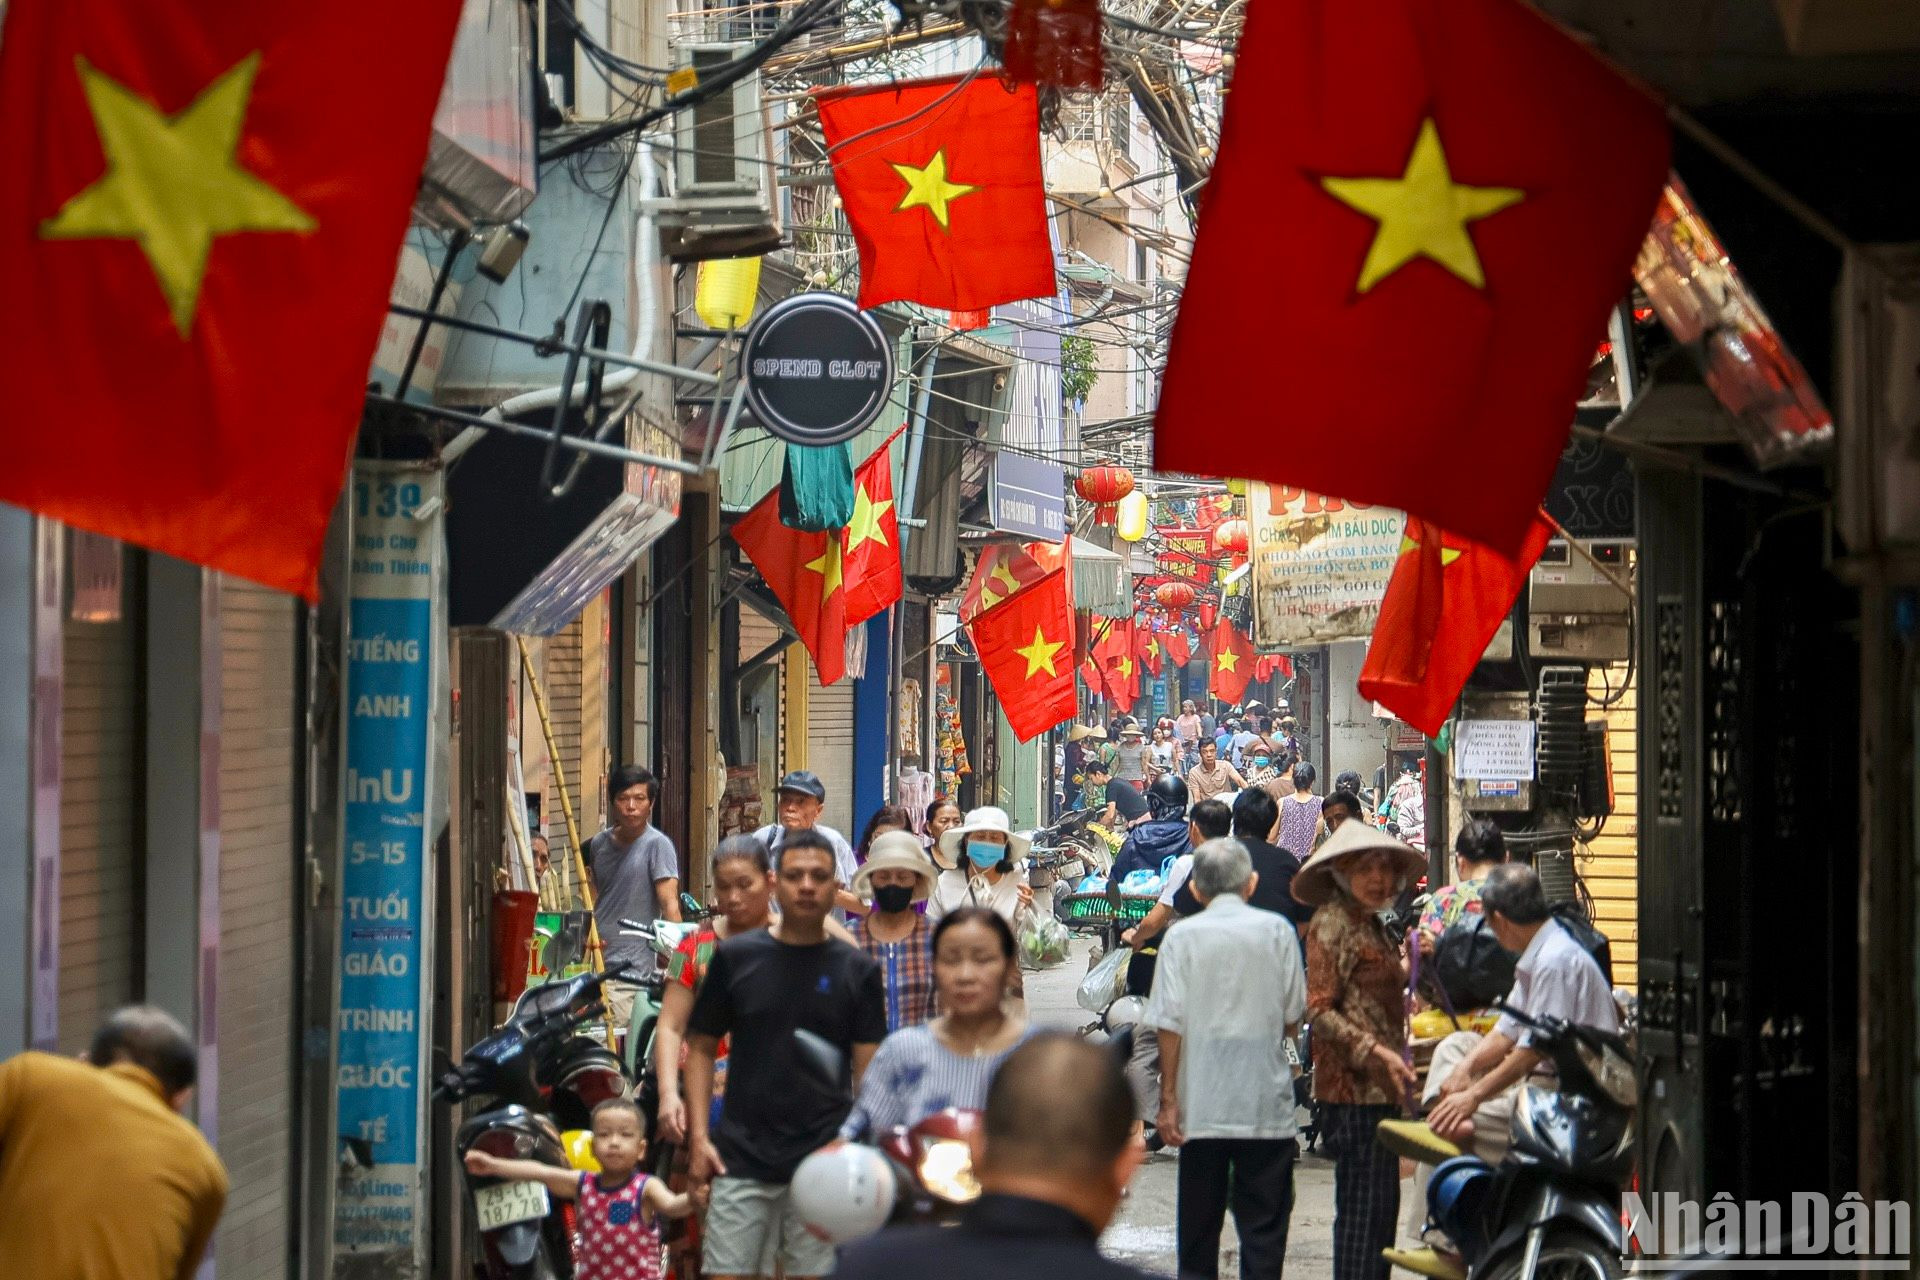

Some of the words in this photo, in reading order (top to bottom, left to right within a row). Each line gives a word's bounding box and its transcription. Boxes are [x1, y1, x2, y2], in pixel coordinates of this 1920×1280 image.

[752, 358, 822, 377] SPEND
[828, 360, 881, 378] CLOT
[1371, 517, 1397, 539] DỤC
[348, 633, 420, 663] TIẾNG
[355, 695, 412, 718] ANH
[351, 841, 407, 865] 5-15
[344, 949, 409, 977] GIÁO
[339, 1004, 415, 1033] TRÌNH
[337, 1058, 412, 1089] QUỐC
[358, 1113, 389, 1143] TẾ
